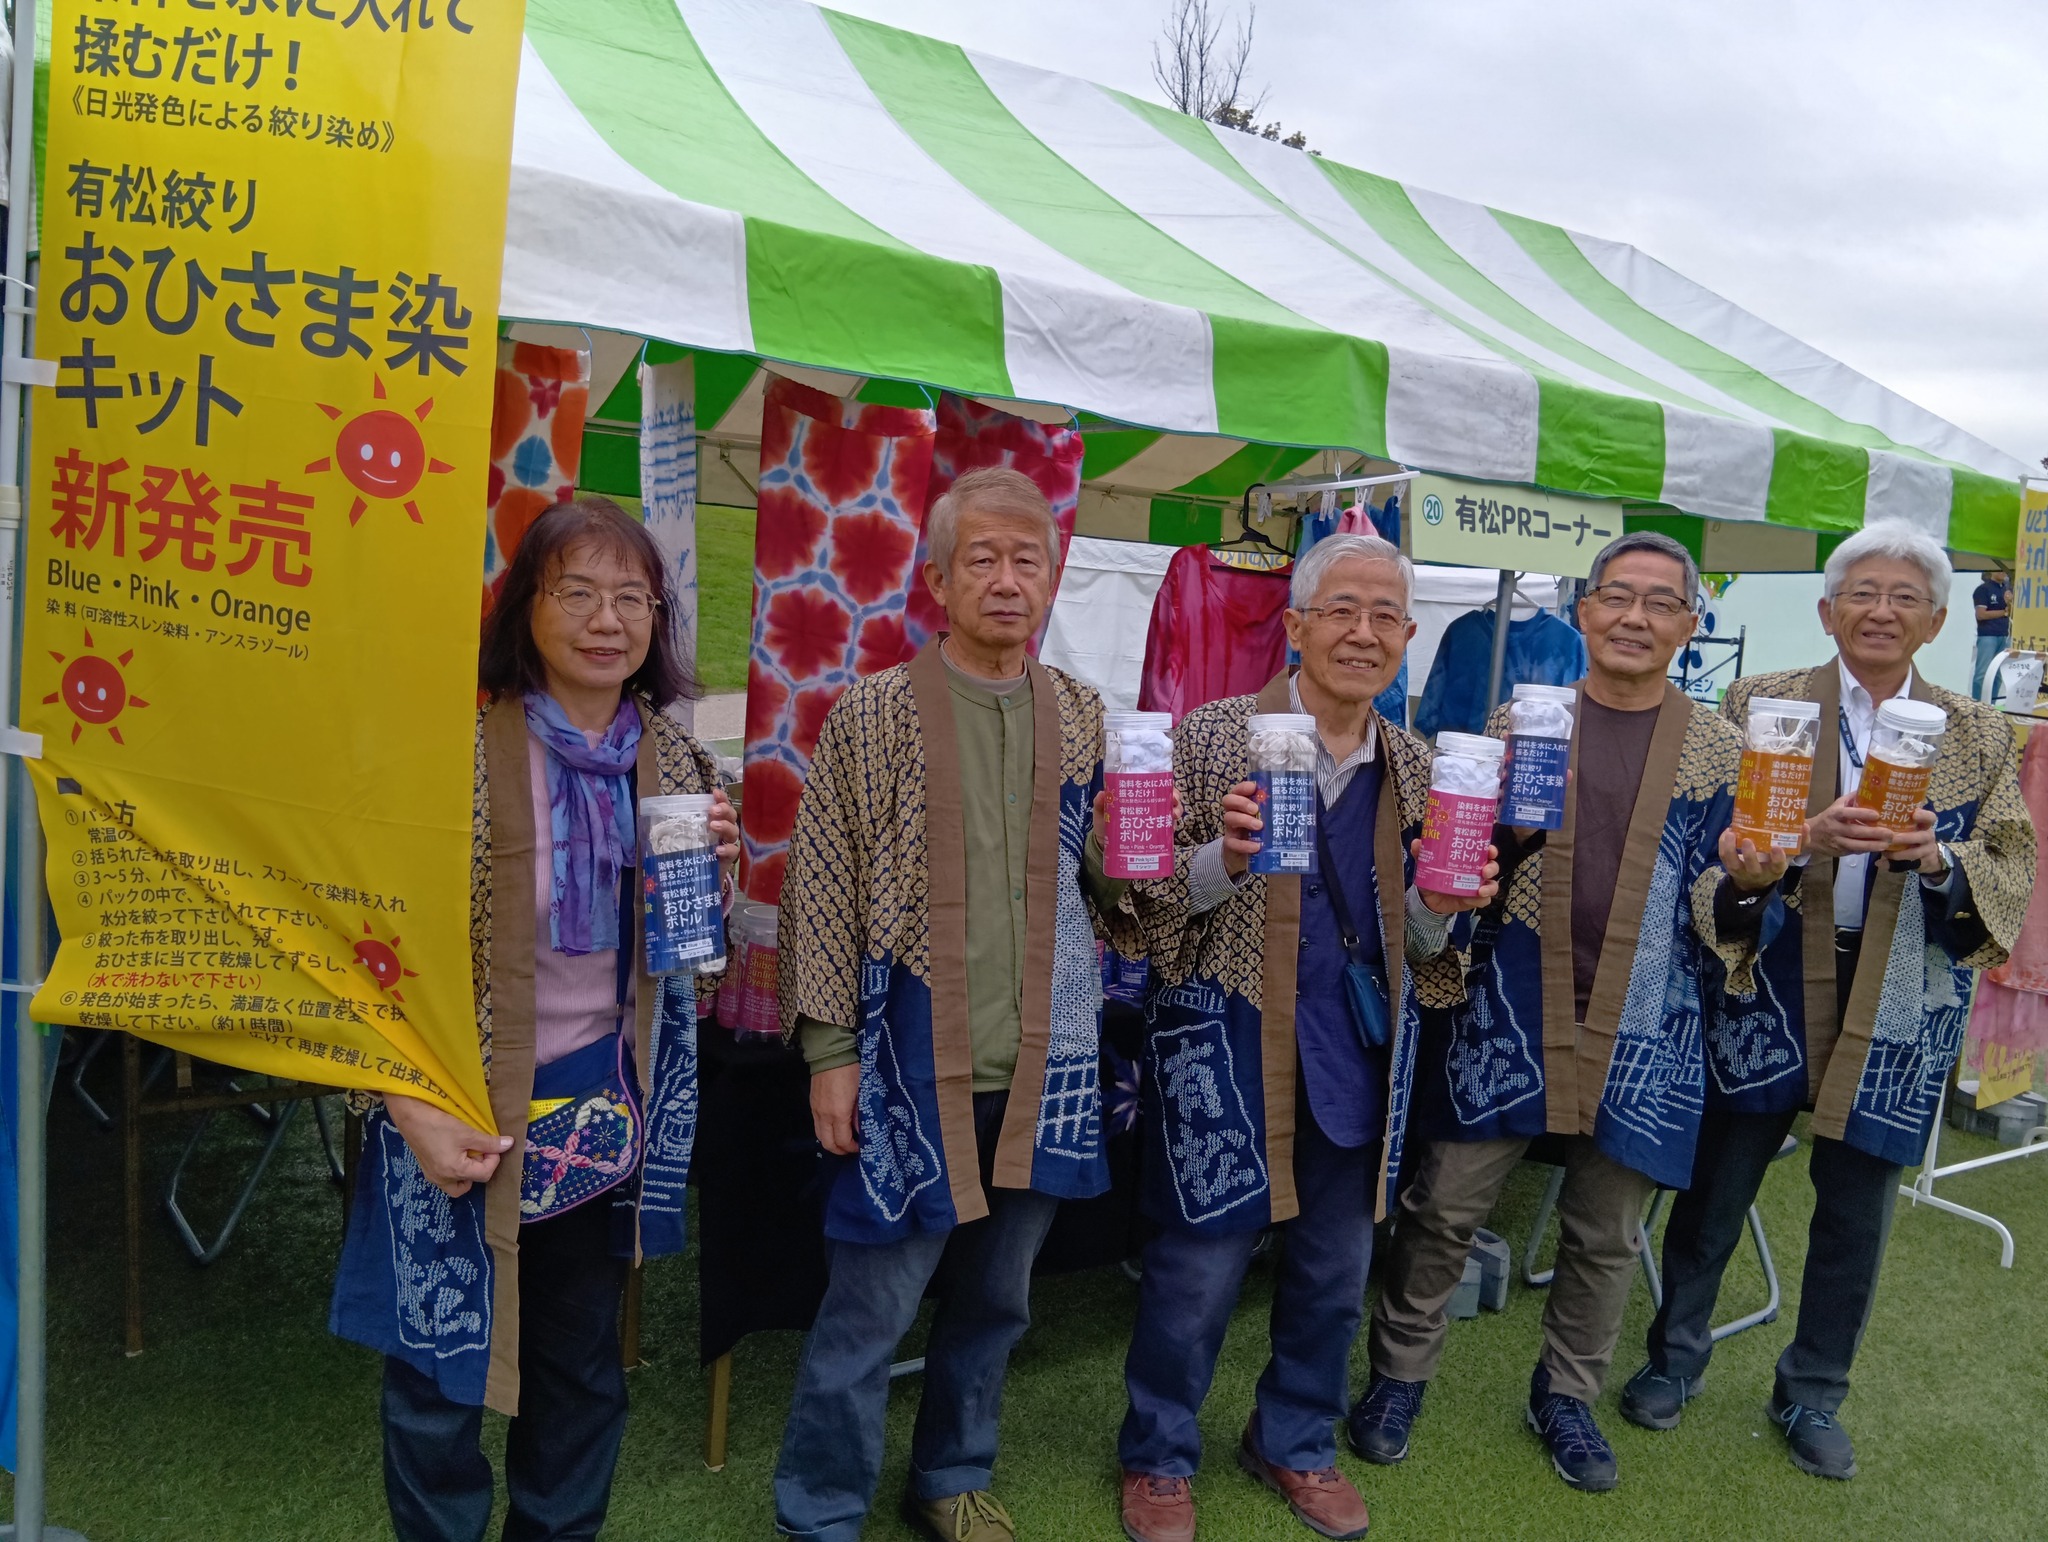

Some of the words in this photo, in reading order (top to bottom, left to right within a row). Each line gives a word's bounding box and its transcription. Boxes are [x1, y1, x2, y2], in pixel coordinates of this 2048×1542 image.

[67, 158, 257, 234] 有松絞り
[59, 230, 472, 377] おひさま染
[55, 337, 244, 447] キット
[49, 447, 315, 588] 新発売
[1455, 495, 1611, 546] 有松PRコーナー
[1512, 784, 1541, 796] ボトル
[1766, 808, 1797, 821] ボトル
[1880, 811, 1910, 823] ボトル
[1120, 830, 1152, 842] ボトル
[1273, 826, 1304, 838] ボトル
[1450, 849, 1480, 863] ボトル
[666, 912, 702, 930] ボトル
